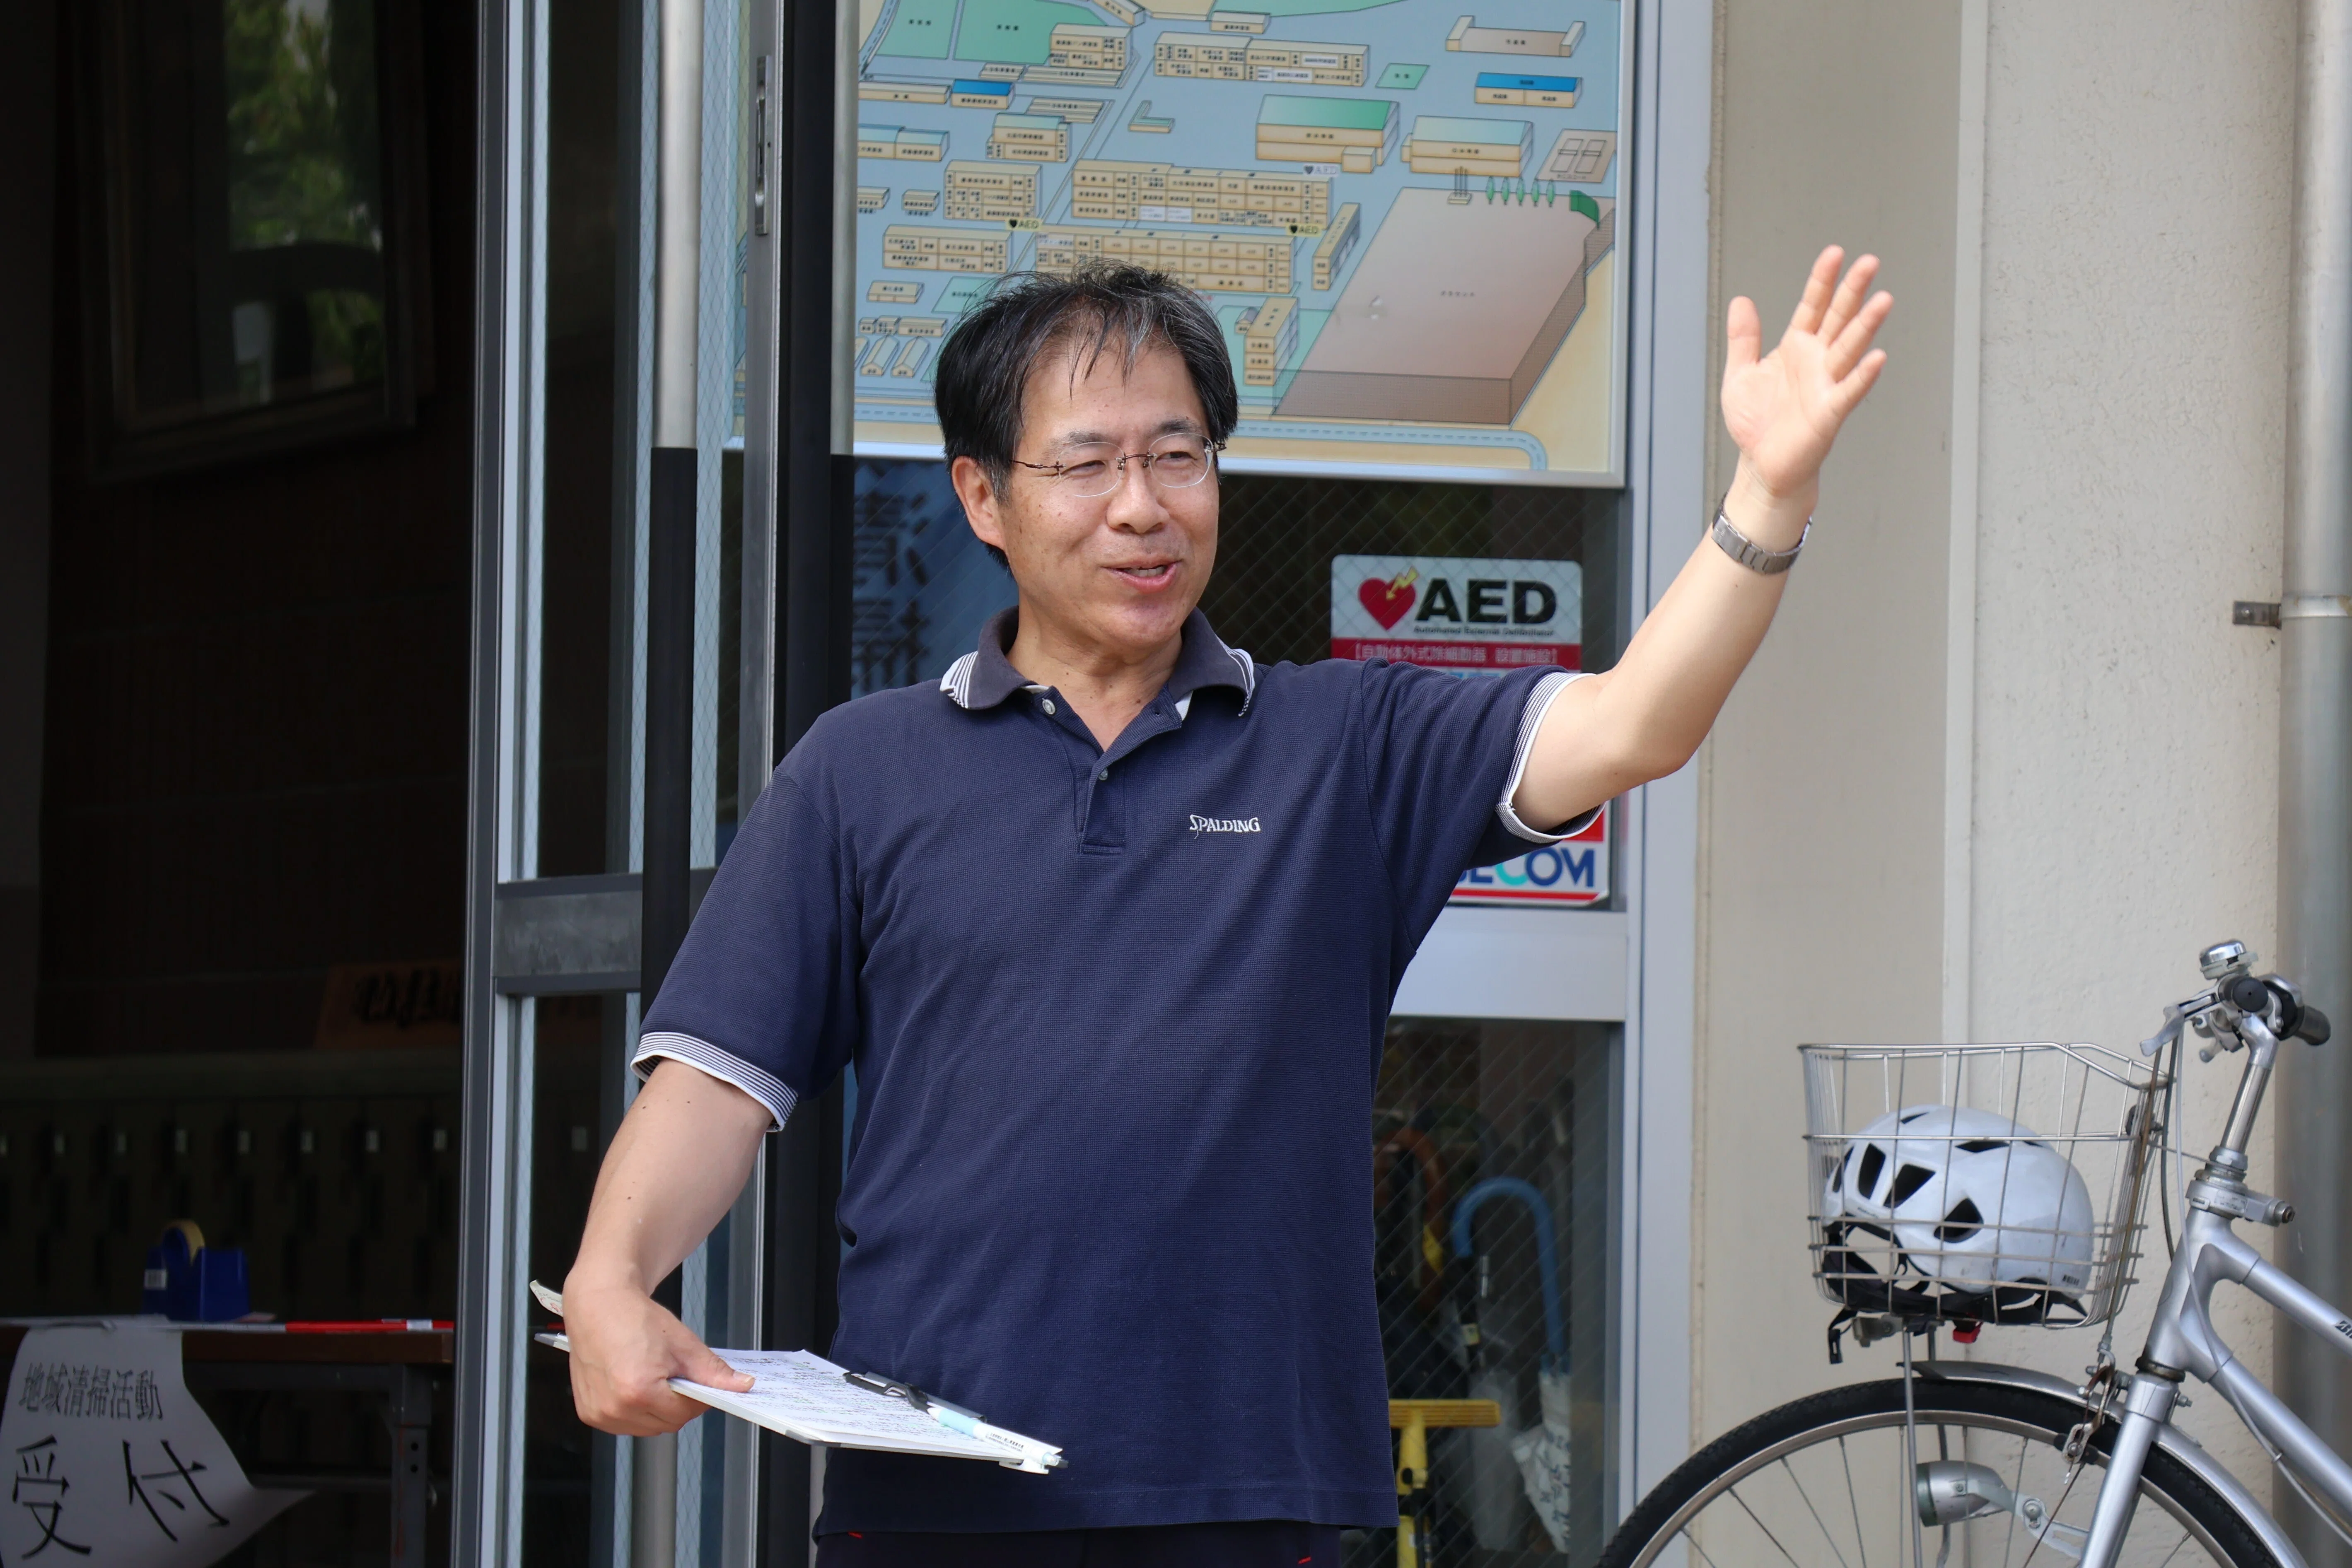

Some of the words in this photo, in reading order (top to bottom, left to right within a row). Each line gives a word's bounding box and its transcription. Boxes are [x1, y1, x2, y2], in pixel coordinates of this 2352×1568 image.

[1018, 220, 1039, 229] AED
[1415, 577, 1557, 624] AED
[1189, 814, 1261, 832] SPALDING
[1458, 847, 1594, 887] COM
[19, 1363, 163, 1420] 地域清掃活動
[12, 1434, 231, 1560] 受付
